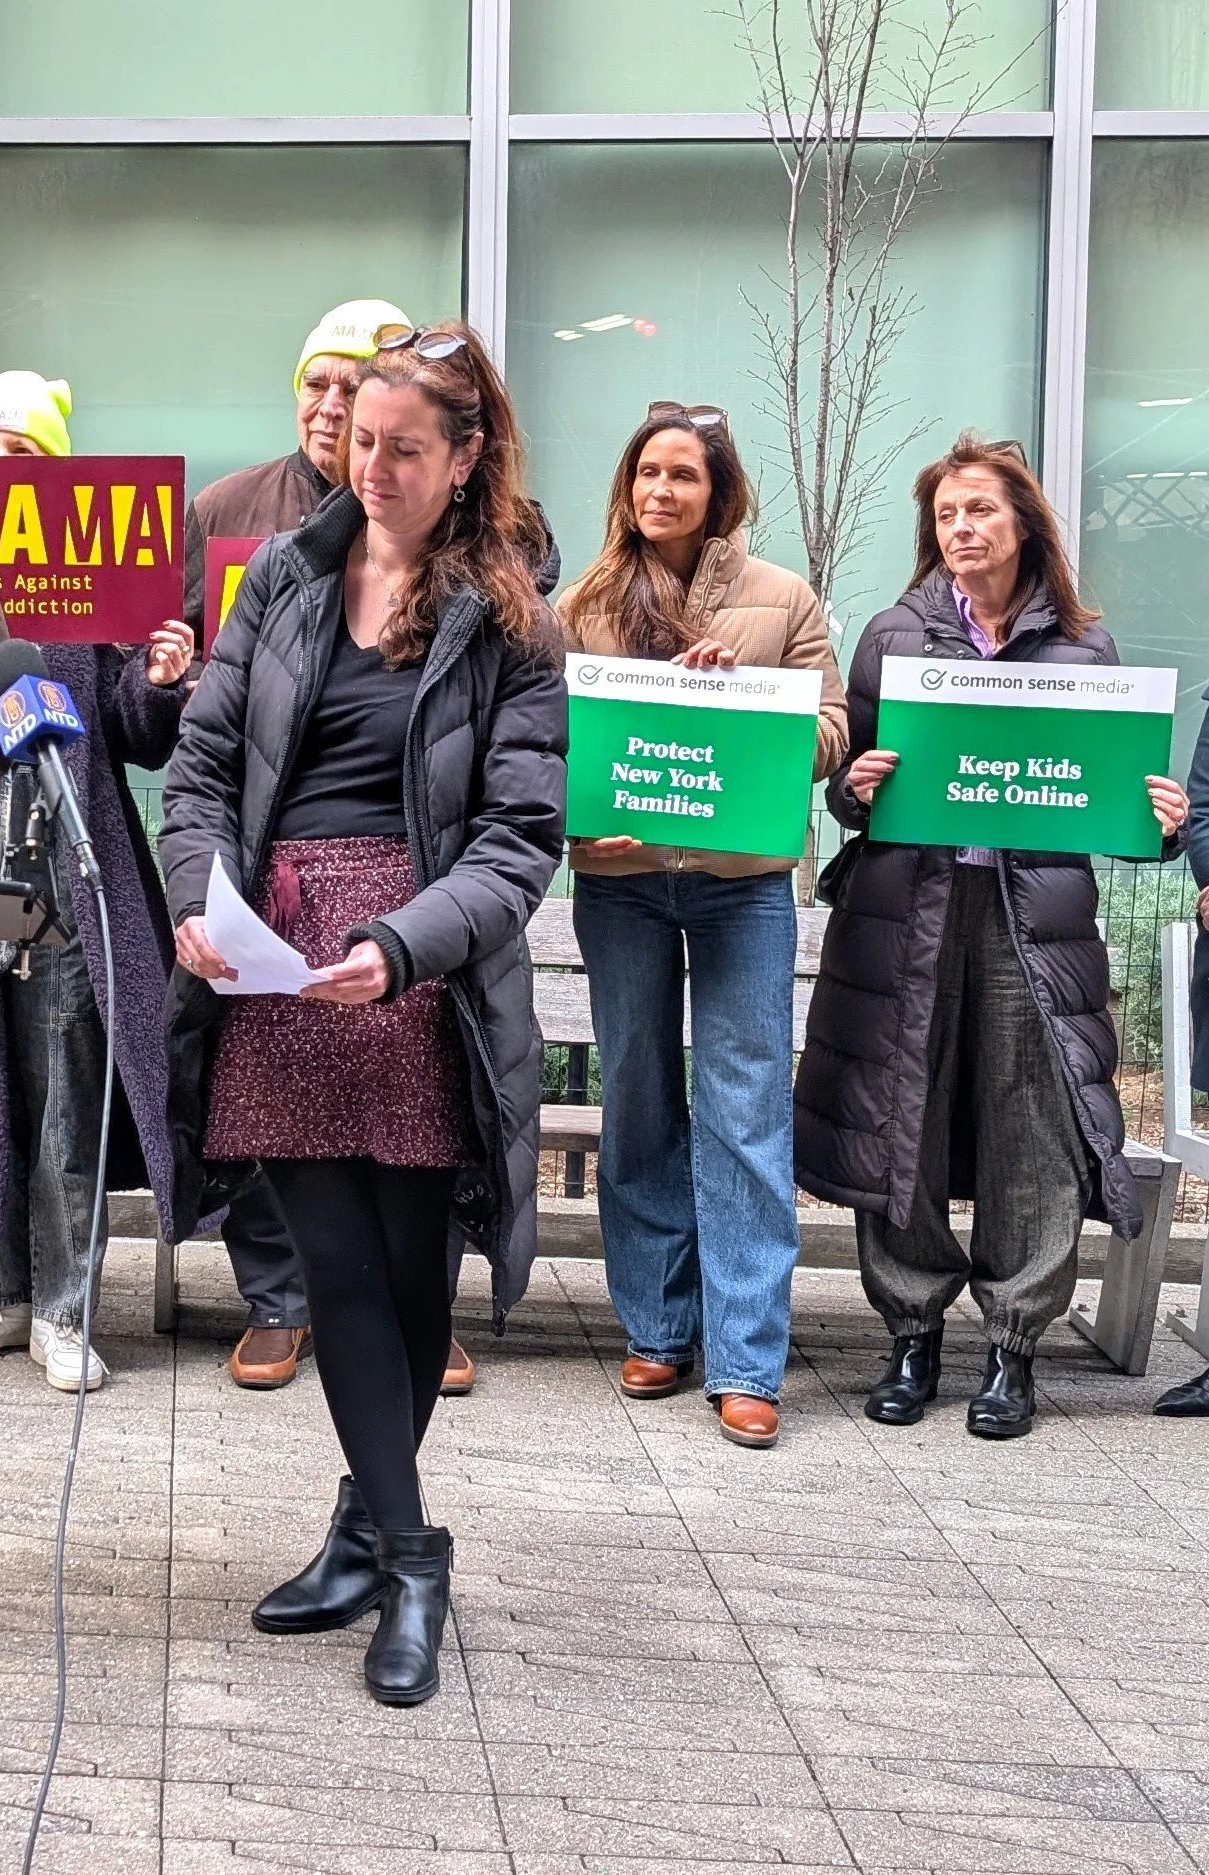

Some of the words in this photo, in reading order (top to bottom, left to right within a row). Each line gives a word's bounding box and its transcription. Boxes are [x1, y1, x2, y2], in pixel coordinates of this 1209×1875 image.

[14, 573, 93, 593] Against
[3, 598, 93, 615] ddiction
[606, 670, 675, 688] common
[679, 676, 726, 692] sense
[950, 674, 1023, 690] common
[1028, 677, 1076, 692] sense
[3, 713, 37, 750] NTD
[44, 708, 79, 728] NTD
[626, 736, 715, 764] Protect
[610, 762, 663, 785] New
[668, 767, 724, 792] York
[958, 755, 1021, 782] Keep
[1026, 757, 1082, 780] Kids
[612, 789, 715, 818] Families
[946, 782, 999, 803] Safe
[1004, 784, 1089, 809] Online
